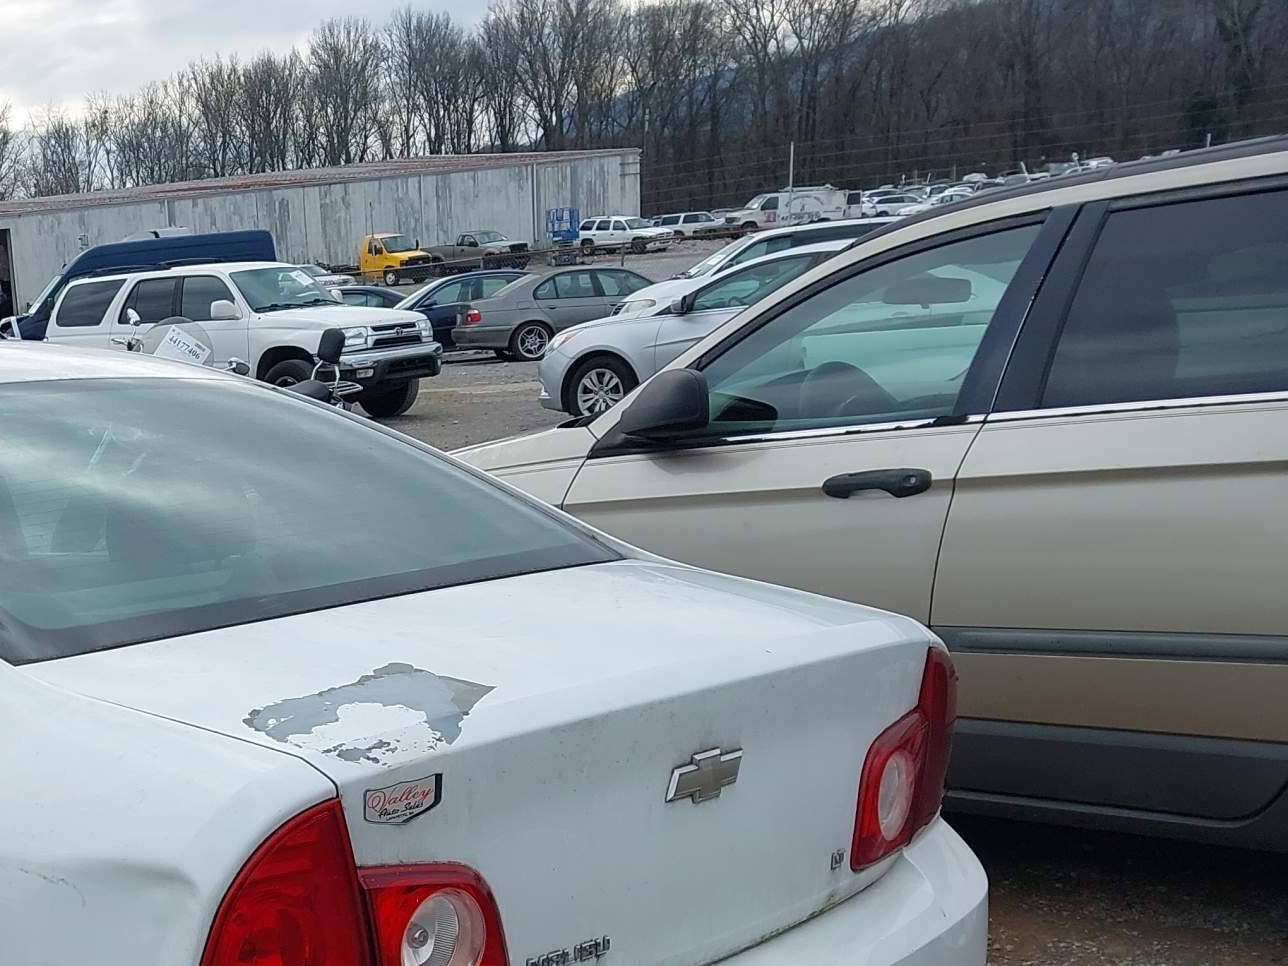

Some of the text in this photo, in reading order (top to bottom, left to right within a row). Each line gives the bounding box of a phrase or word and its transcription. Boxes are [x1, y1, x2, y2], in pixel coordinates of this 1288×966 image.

[367, 785, 432, 813] Valley
[378, 808, 399, 818] Auto
[404, 800, 423, 810] Sales
